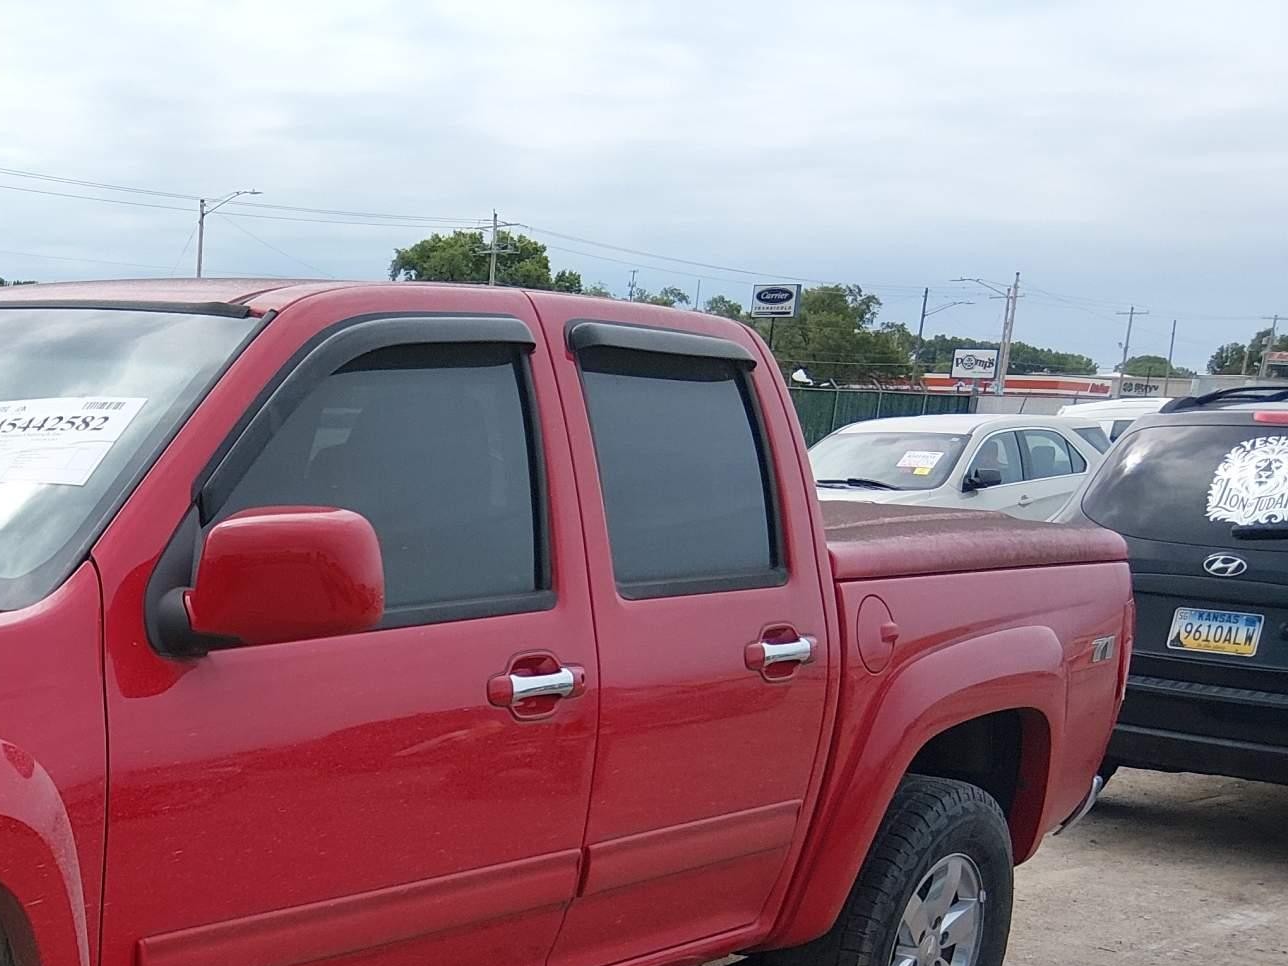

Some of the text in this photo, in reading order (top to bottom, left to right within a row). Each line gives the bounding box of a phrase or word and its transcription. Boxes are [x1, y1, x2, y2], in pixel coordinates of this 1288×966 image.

[760, 291, 790, 300] Carrier
[1213, 478, 1249, 512] LION
[1197, 612, 1241, 624] KANSAS
[1183, 622, 1256, 646] 9610ALW
